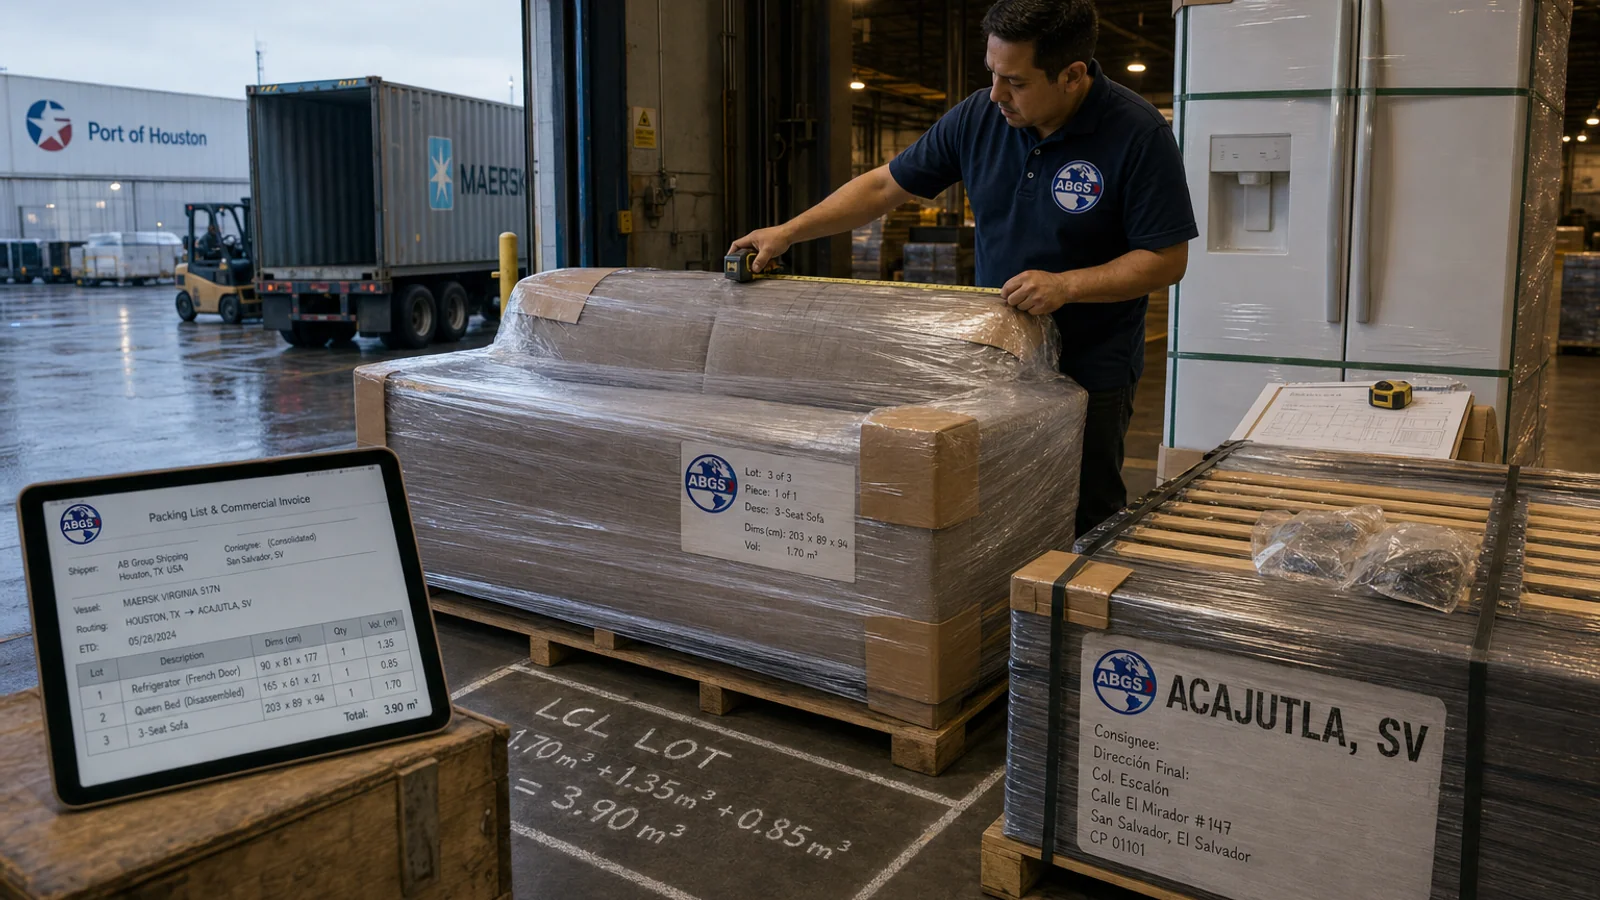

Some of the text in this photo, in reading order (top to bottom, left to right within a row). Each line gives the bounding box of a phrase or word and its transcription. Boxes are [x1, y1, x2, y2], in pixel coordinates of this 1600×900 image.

[88, 122, 207, 146] Port of Houston
[1055, 180, 1092, 193] ABGS
[688, 474, 726, 492] ABGS
[746, 468, 792, 482] Lot: 3 of 3
[745, 484, 797, 500] Piece: 1 of 1
[149, 495, 310, 522] Packing List & Commercial Invoice
[745, 502, 824, 524] Desc: 3-Seat Sofa
[63, 520, 93, 530] ABGS
[744, 523, 765, 535] Dims
[766, 526, 786, 538] (cm):
[789, 531, 804, 542] 203
[816, 535, 827, 545] 89
[838, 538, 848, 549] 94
[226, 550, 284, 566] San Salvador, SV
[744, 540, 761, 552] Vol:
[787, 546, 804, 558] 1.70
[68, 553, 188, 576] Shipper: AB Group Shipping
[153, 568, 164, 576] TX
[166, 565, 184, 574] USA
[73, 604, 101, 614] Vessel:
[122, 596, 160, 608] MAERSK
[160, 588, 198, 602] VIRGINIA
[76, 623, 108, 634] Routing:
[126, 613, 168, 626] HOUSTON,
[170, 610, 180, 618] TX
[242, 599, 252, 608] SV
[80, 630, 177, 654] ETD: 05/28/2024
[90, 668, 104, 678] Lot
[160, 652, 204, 666] Description
[264, 638, 284, 648] Dims
[285, 634, 302, 645] (cm)
[334, 627, 348, 636] Qty
[132, 678, 180, 694] Refrigerator
[186, 673, 216, 686] (French
[218, 666, 241, 678] Door)
[260, 661, 270, 670] 90
[283, 658, 292, 666] 81
[304, 652, 318, 663] 177
[378, 638, 394, 649] 1.35
[100, 713, 106, 722] 2
[135, 705, 162, 716] Queen
[164, 701, 181, 711] Bed
[184, 686, 244, 706] (Disassembled)
[263, 681, 278, 692] 165
[290, 677, 300, 687] 61
[312, 673, 321, 682] 21
[380, 658, 398, 670] 0.85
[1096, 670, 1142, 692] ABGS
[104, 736, 110, 746] 3
[138, 724, 168, 738] 3-Seat
[170, 720, 188, 732] Sofa
[265, 702, 282, 714] 203
[285, 702, 290, 710] x
[292, 698, 302, 708] 89
[314, 694, 325, 704] 94
[385, 678, 402, 690] 1.70
[344, 709, 368, 722] Total:
[384, 702, 404, 715] 3.90
[1166, 674, 1429, 763] ACAJUTLA, SV
[535, 698, 732, 769] LCL LOT
[1094, 724, 1159, 750] Consignee:
[1094, 746, 1189, 780] Dirección Final:
[1092, 766, 1169, 797] Col. Escalón
[1092, 788, 1121, 806] Calle
[1126, 796, 1138, 811] El
[1142, 800, 1189, 824] Mirador
[1090, 830, 1145, 856] CP 01101
[1091, 809, 1251, 862] San Salvador, El Salvador
